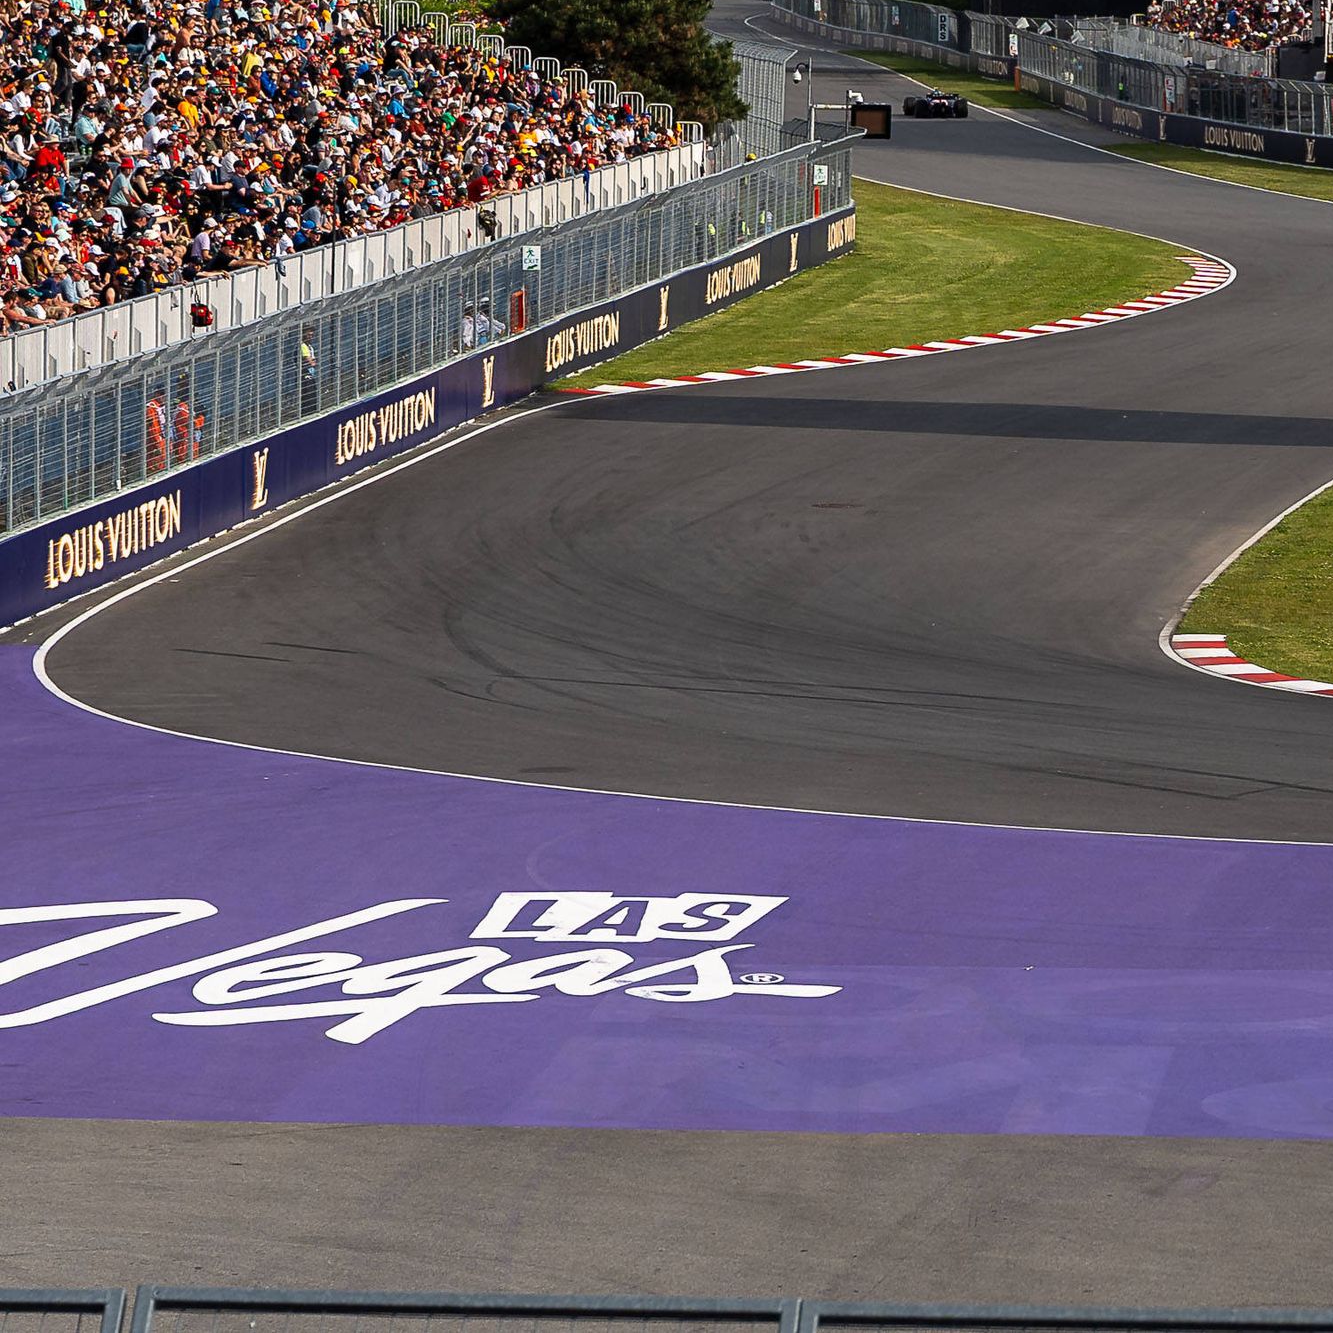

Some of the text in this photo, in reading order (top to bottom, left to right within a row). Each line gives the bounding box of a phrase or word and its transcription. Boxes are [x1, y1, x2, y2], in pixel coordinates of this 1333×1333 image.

[1205, 125, 1265, 153] LOUIS VUITTON
[705, 253, 761, 304] LOUIS VUITTON
[546, 311, 619, 373] LOUIS VUITTON
[336, 386, 435, 466] LOUIS VUITTON
[46, 489, 181, 589] LOUIS VUITTON
[503, 896, 760, 938] LAS
